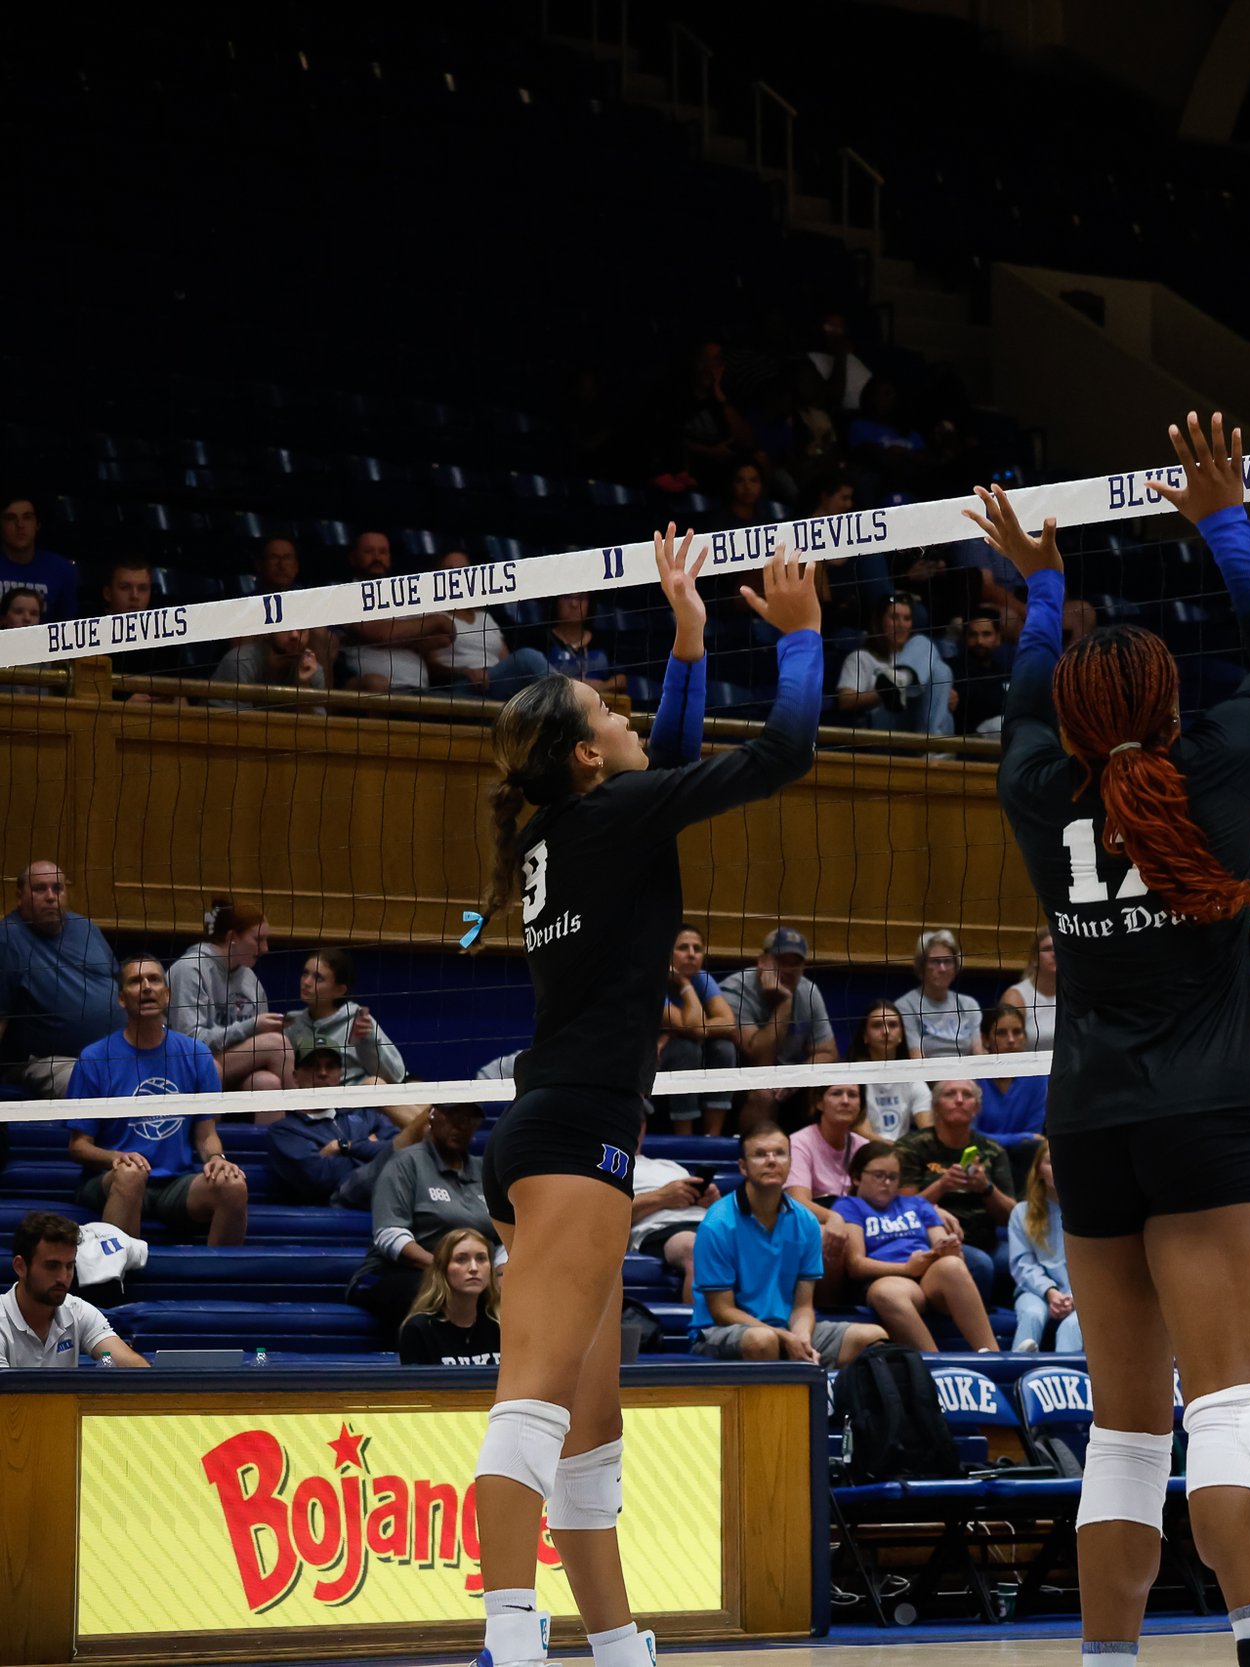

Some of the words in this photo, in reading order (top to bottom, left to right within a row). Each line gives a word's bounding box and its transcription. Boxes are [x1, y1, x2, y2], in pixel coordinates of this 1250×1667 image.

[711, 525, 779, 565] BLUE
[792, 510, 888, 553] DEVILS
[360, 574, 421, 611] BLUE
[432, 562, 517, 602] DEVILS
[47, 618, 101, 652] BLUE
[111, 607, 188, 644] DEVILS
[521, 839, 548, 925] 9
[524, 910, 582, 953] Devils
[1054, 911, 1114, 938] Blue
[865, 1210, 922, 1237] DUKE
